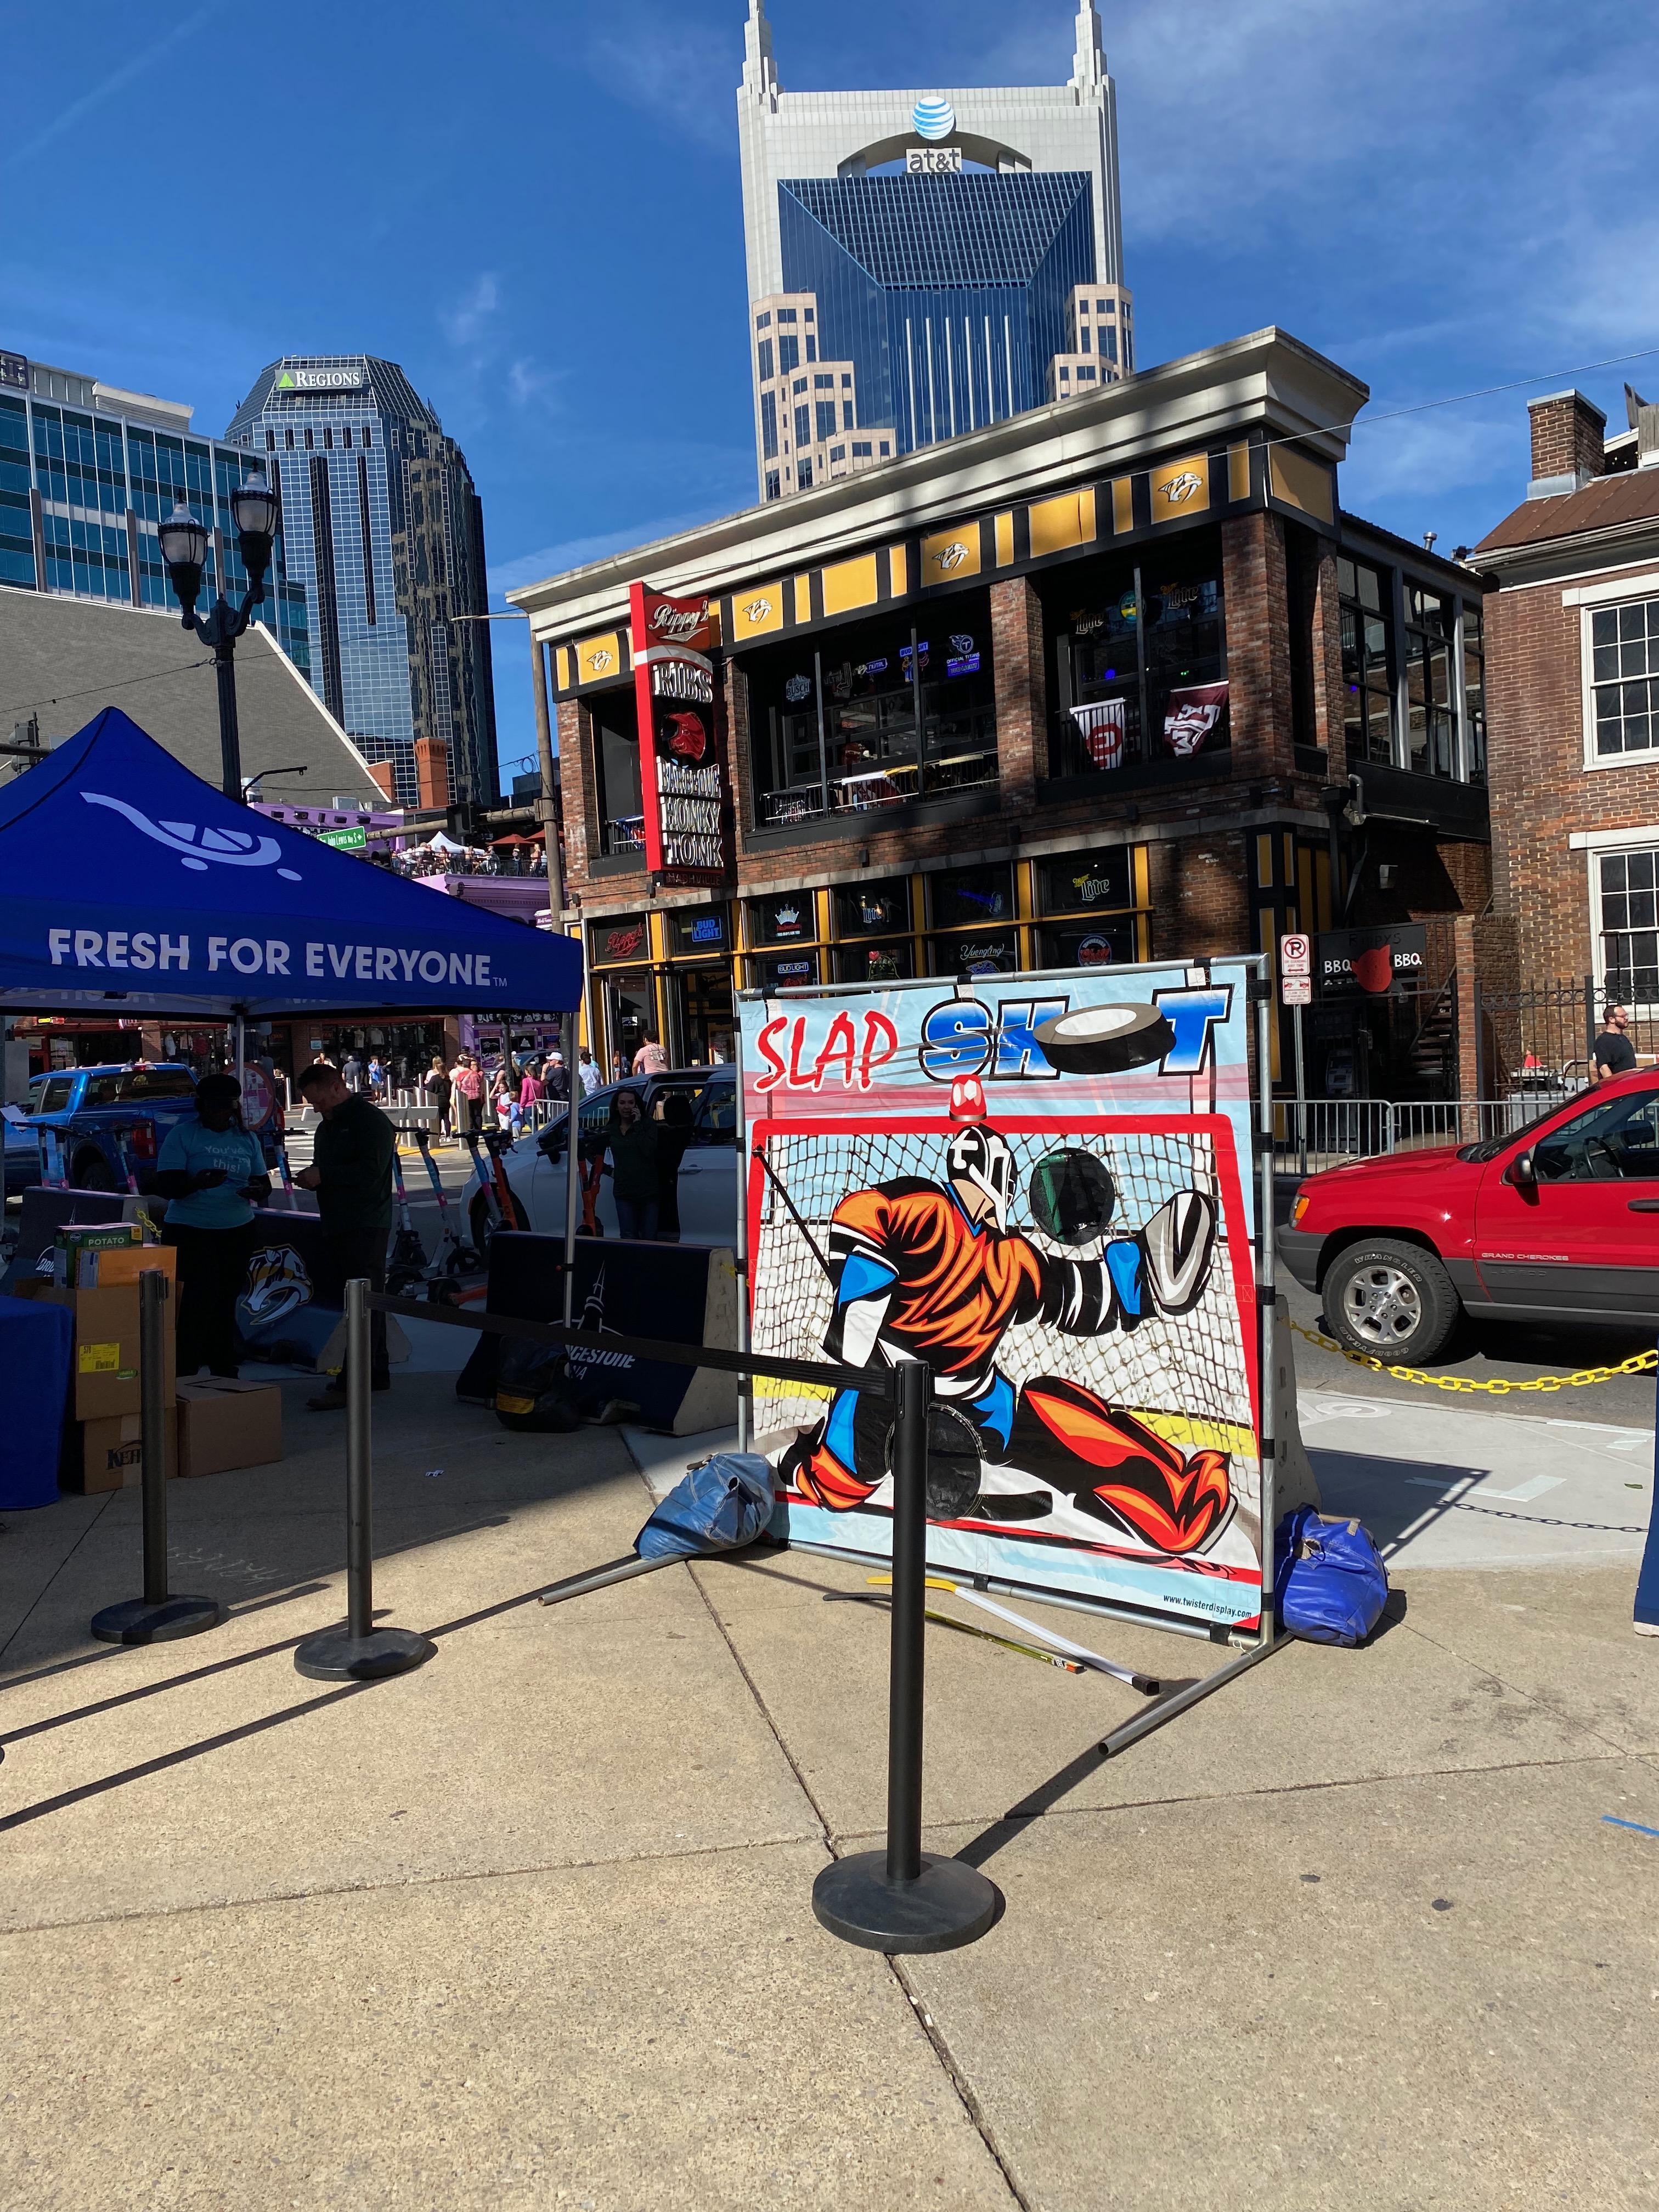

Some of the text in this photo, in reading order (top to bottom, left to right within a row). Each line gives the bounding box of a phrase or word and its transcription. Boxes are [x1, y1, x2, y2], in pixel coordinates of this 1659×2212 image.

[910, 149, 961, 173] at&t
[295, 371, 360, 387] REGIONS
[648, 600, 709, 633] Rippy's
[652, 662, 713, 703] RIBS
[787, 682, 809, 696] BUSCH
[660, 796, 721, 835] HONKY
[336, 833, 347, 845] Lewis
[353, 832, 357, 844] S
[662, 832, 724, 868] TONK
[1081, 879, 1110, 901] Lite
[693, 927, 720, 940] LIGHT
[696, 919, 715, 929] BUD
[48, 928, 190, 970] FRESH
[208, 936, 291, 975] FOR
[306, 942, 491, 986] EVERYONE
[960, 943, 1005, 960] Yuengling
[1394, 952, 1423, 968] BBQ
[1324, 959, 1352, 974] BBQ
[754, 1008, 898, 1094] SLAP
[204, 1145, 242, 1154] You've
[213, 1158, 240, 1173] this!
[88, 1237, 125, 1246] POTATO
[1354, 1254, 1423, 1282] WRANGLER
[1340, 1327, 1409, 1357] GOODYEAR
[1163, 1594, 1252, 1618] www.twisterdisplay.com
